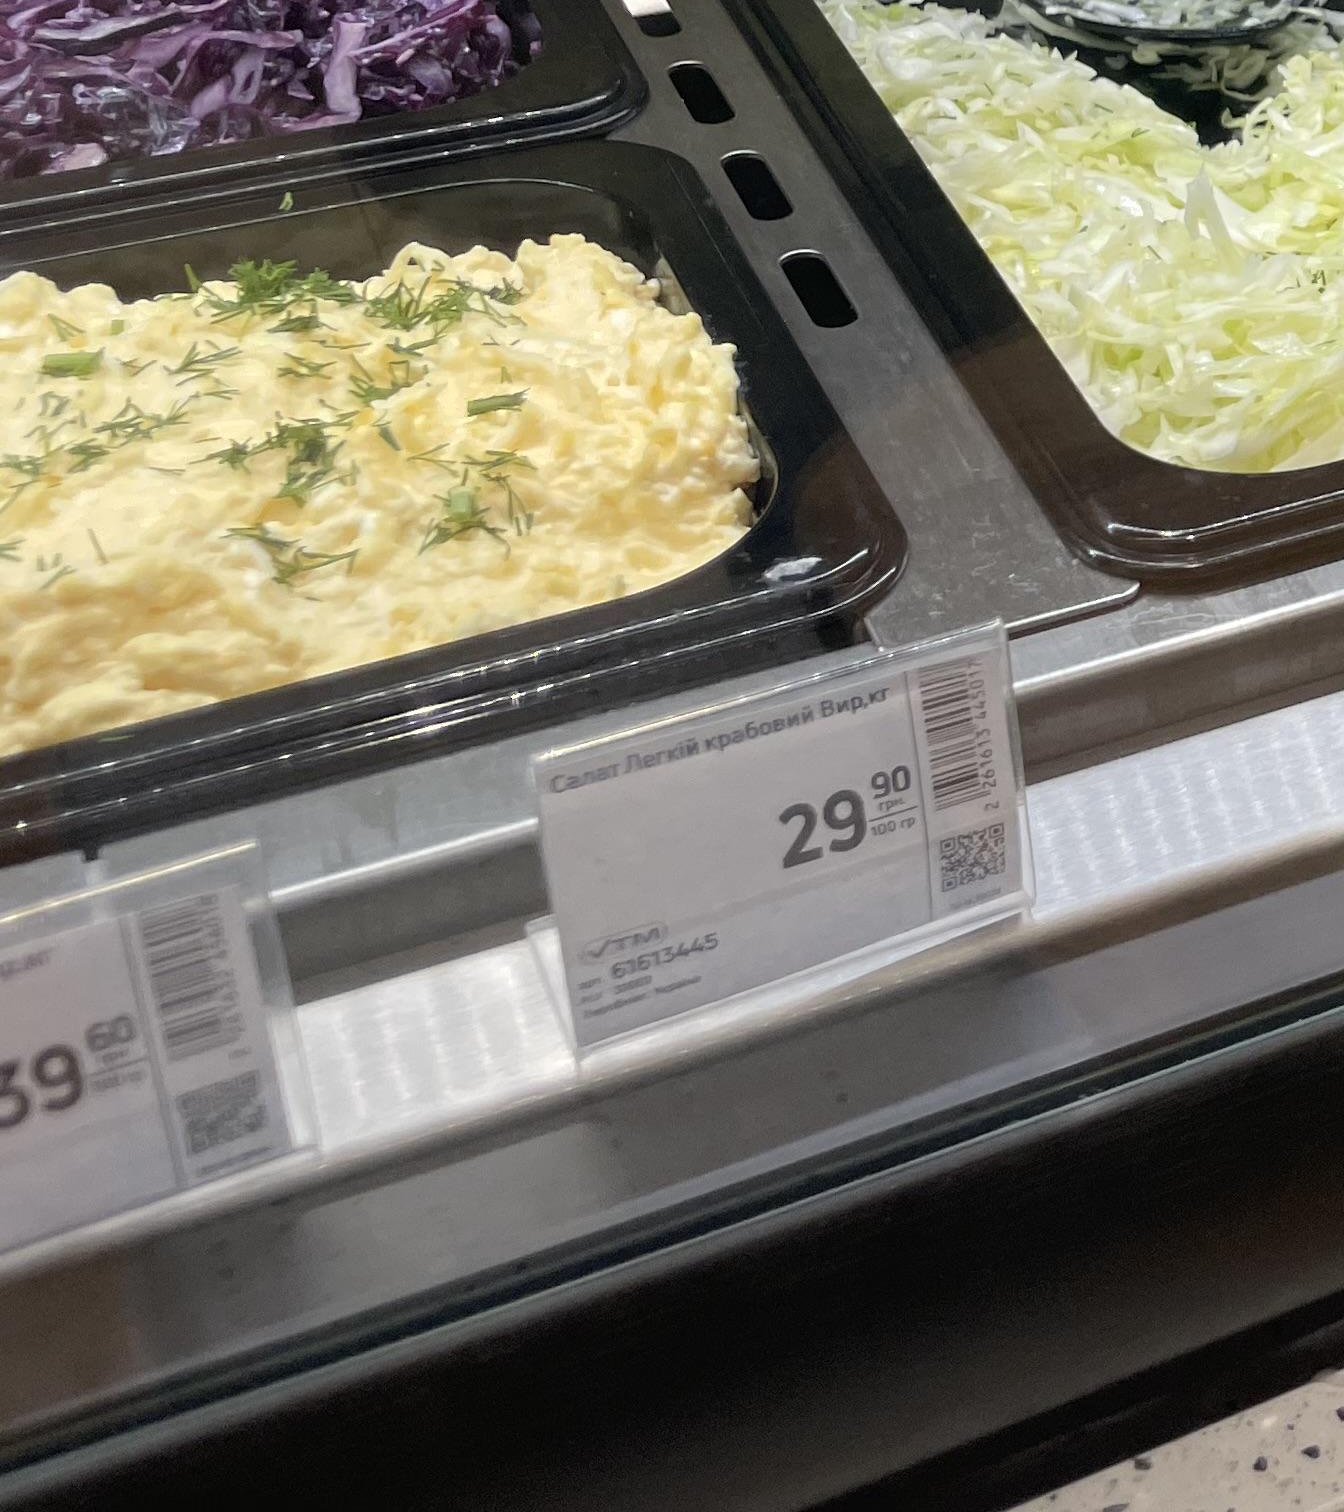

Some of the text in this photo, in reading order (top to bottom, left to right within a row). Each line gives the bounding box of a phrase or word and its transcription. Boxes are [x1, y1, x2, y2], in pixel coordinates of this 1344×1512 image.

[549, 761, 620, 794] Салат
[624, 736, 700, 776] Легкій
[704, 707, 816, 757] крабовий
[976, 727, 999, 794] 261613
[871, 765, 911, 799] 90
[779, 789, 867, 869] 29
[871, 816, 916, 836] 100 гр
[611, 933, 719, 980] 61613445
